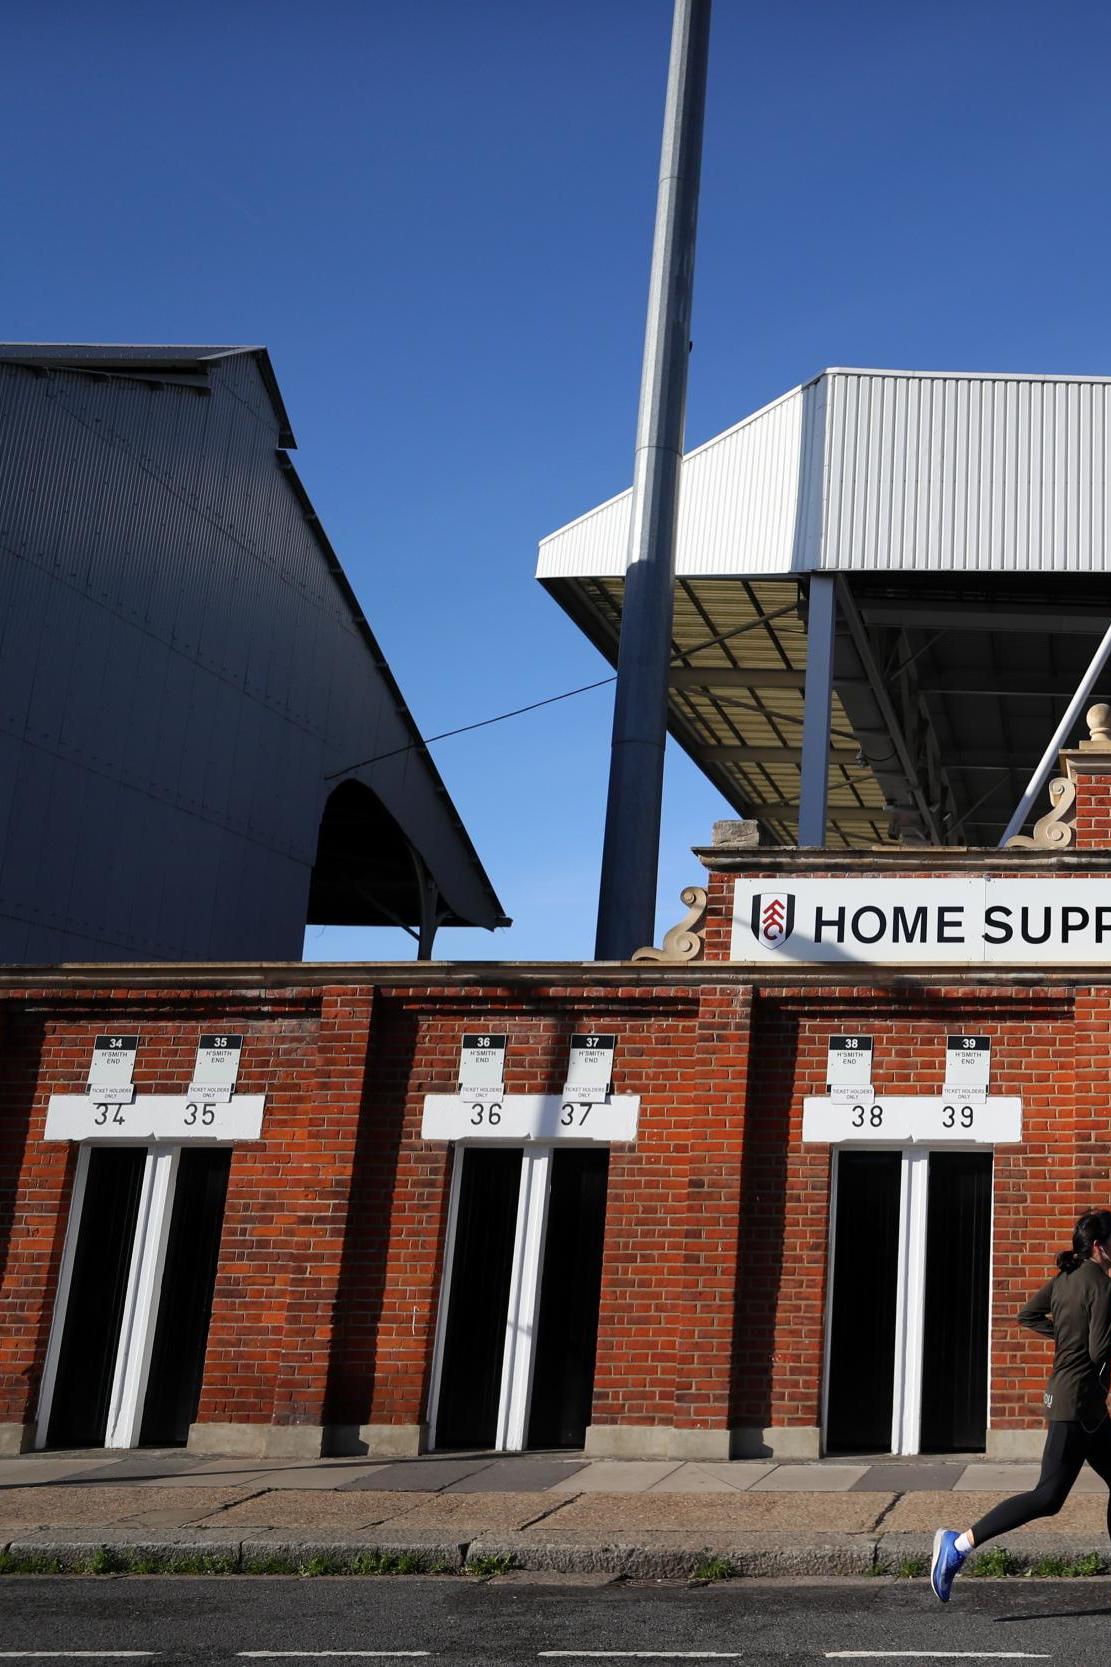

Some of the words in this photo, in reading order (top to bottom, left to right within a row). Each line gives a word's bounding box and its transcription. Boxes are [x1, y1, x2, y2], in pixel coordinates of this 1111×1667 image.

[814, 905, 965, 944] HOME
[110, 1039, 122, 1048] 34
[214, 1038, 227, 1047] 35
[477, 1038, 490, 1047] 36
[586, 1038, 599, 1047] 37
[845, 1039, 858, 1048] 38
[963, 1039, 976, 1048] 39
[94, 1104, 125, 1125] 34
[184, 1104, 216, 1125] 35
[471, 1104, 501, 1125] 36
[561, 1104, 593, 1125] 37
[852, 1106, 883, 1127] 38
[943, 1106, 973, 1128] 39
